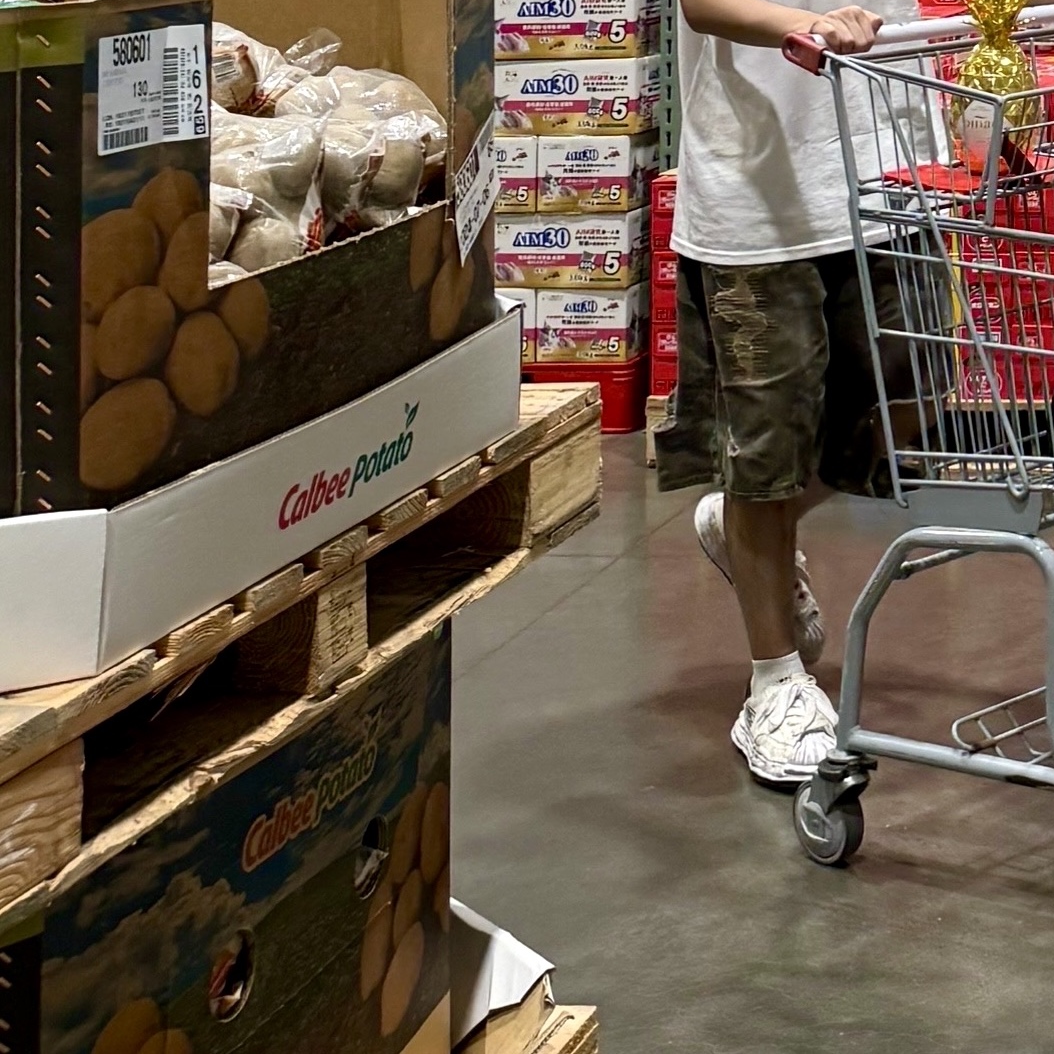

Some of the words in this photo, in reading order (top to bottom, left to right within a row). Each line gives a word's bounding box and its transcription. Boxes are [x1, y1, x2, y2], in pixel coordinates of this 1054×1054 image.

[608, 18, 628, 44] 5
[521, 74, 579, 95] AIM30
[610, 96, 630, 121] 5
[516, 185, 529, 202] 5
[609, 184, 621, 201] 5
[512, 227, 571, 249] AIM30
[603, 250, 622, 276] 5
[607, 336, 620, 353] 5
